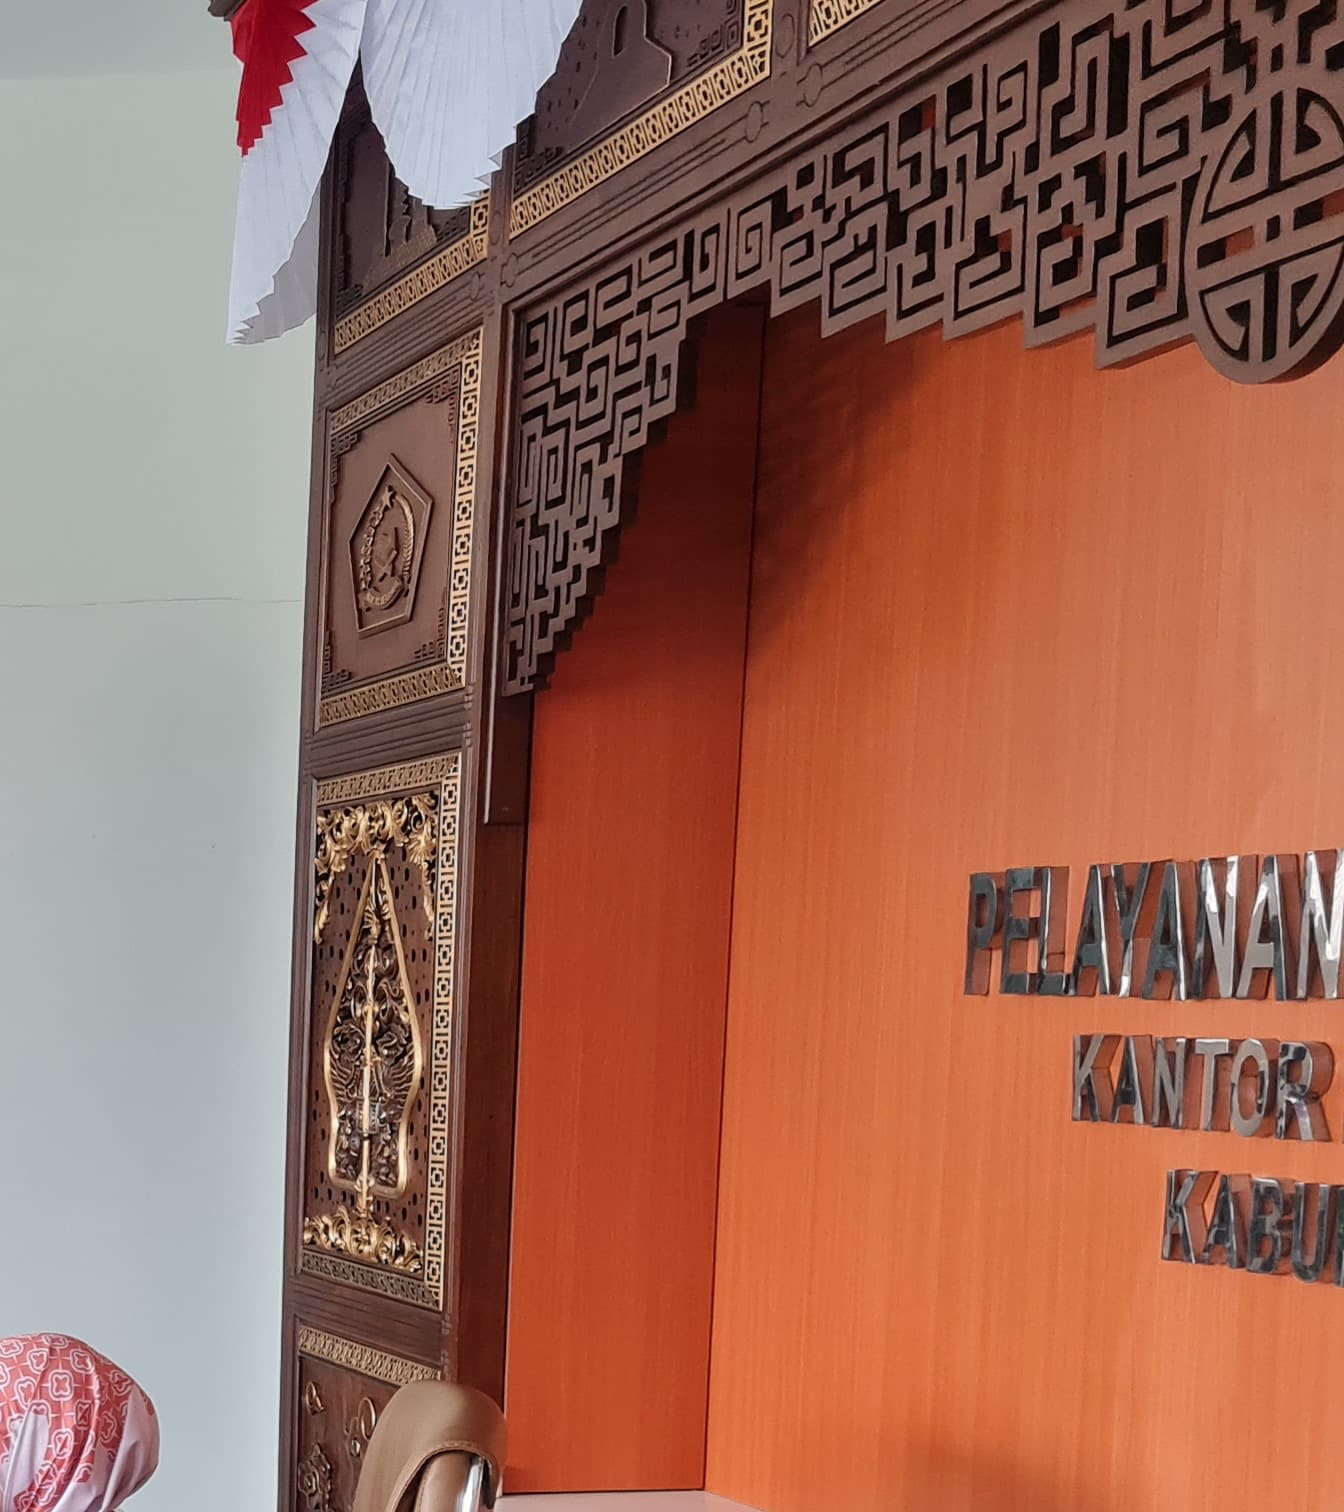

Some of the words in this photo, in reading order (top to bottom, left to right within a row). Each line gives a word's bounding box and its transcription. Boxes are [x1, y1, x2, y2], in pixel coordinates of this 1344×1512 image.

[964, 847, 1344, 1001] PELAYANAN
[1072, 1034, 1330, 1142] KANTOR
[1161, 1168, 1344, 1284] KABU
